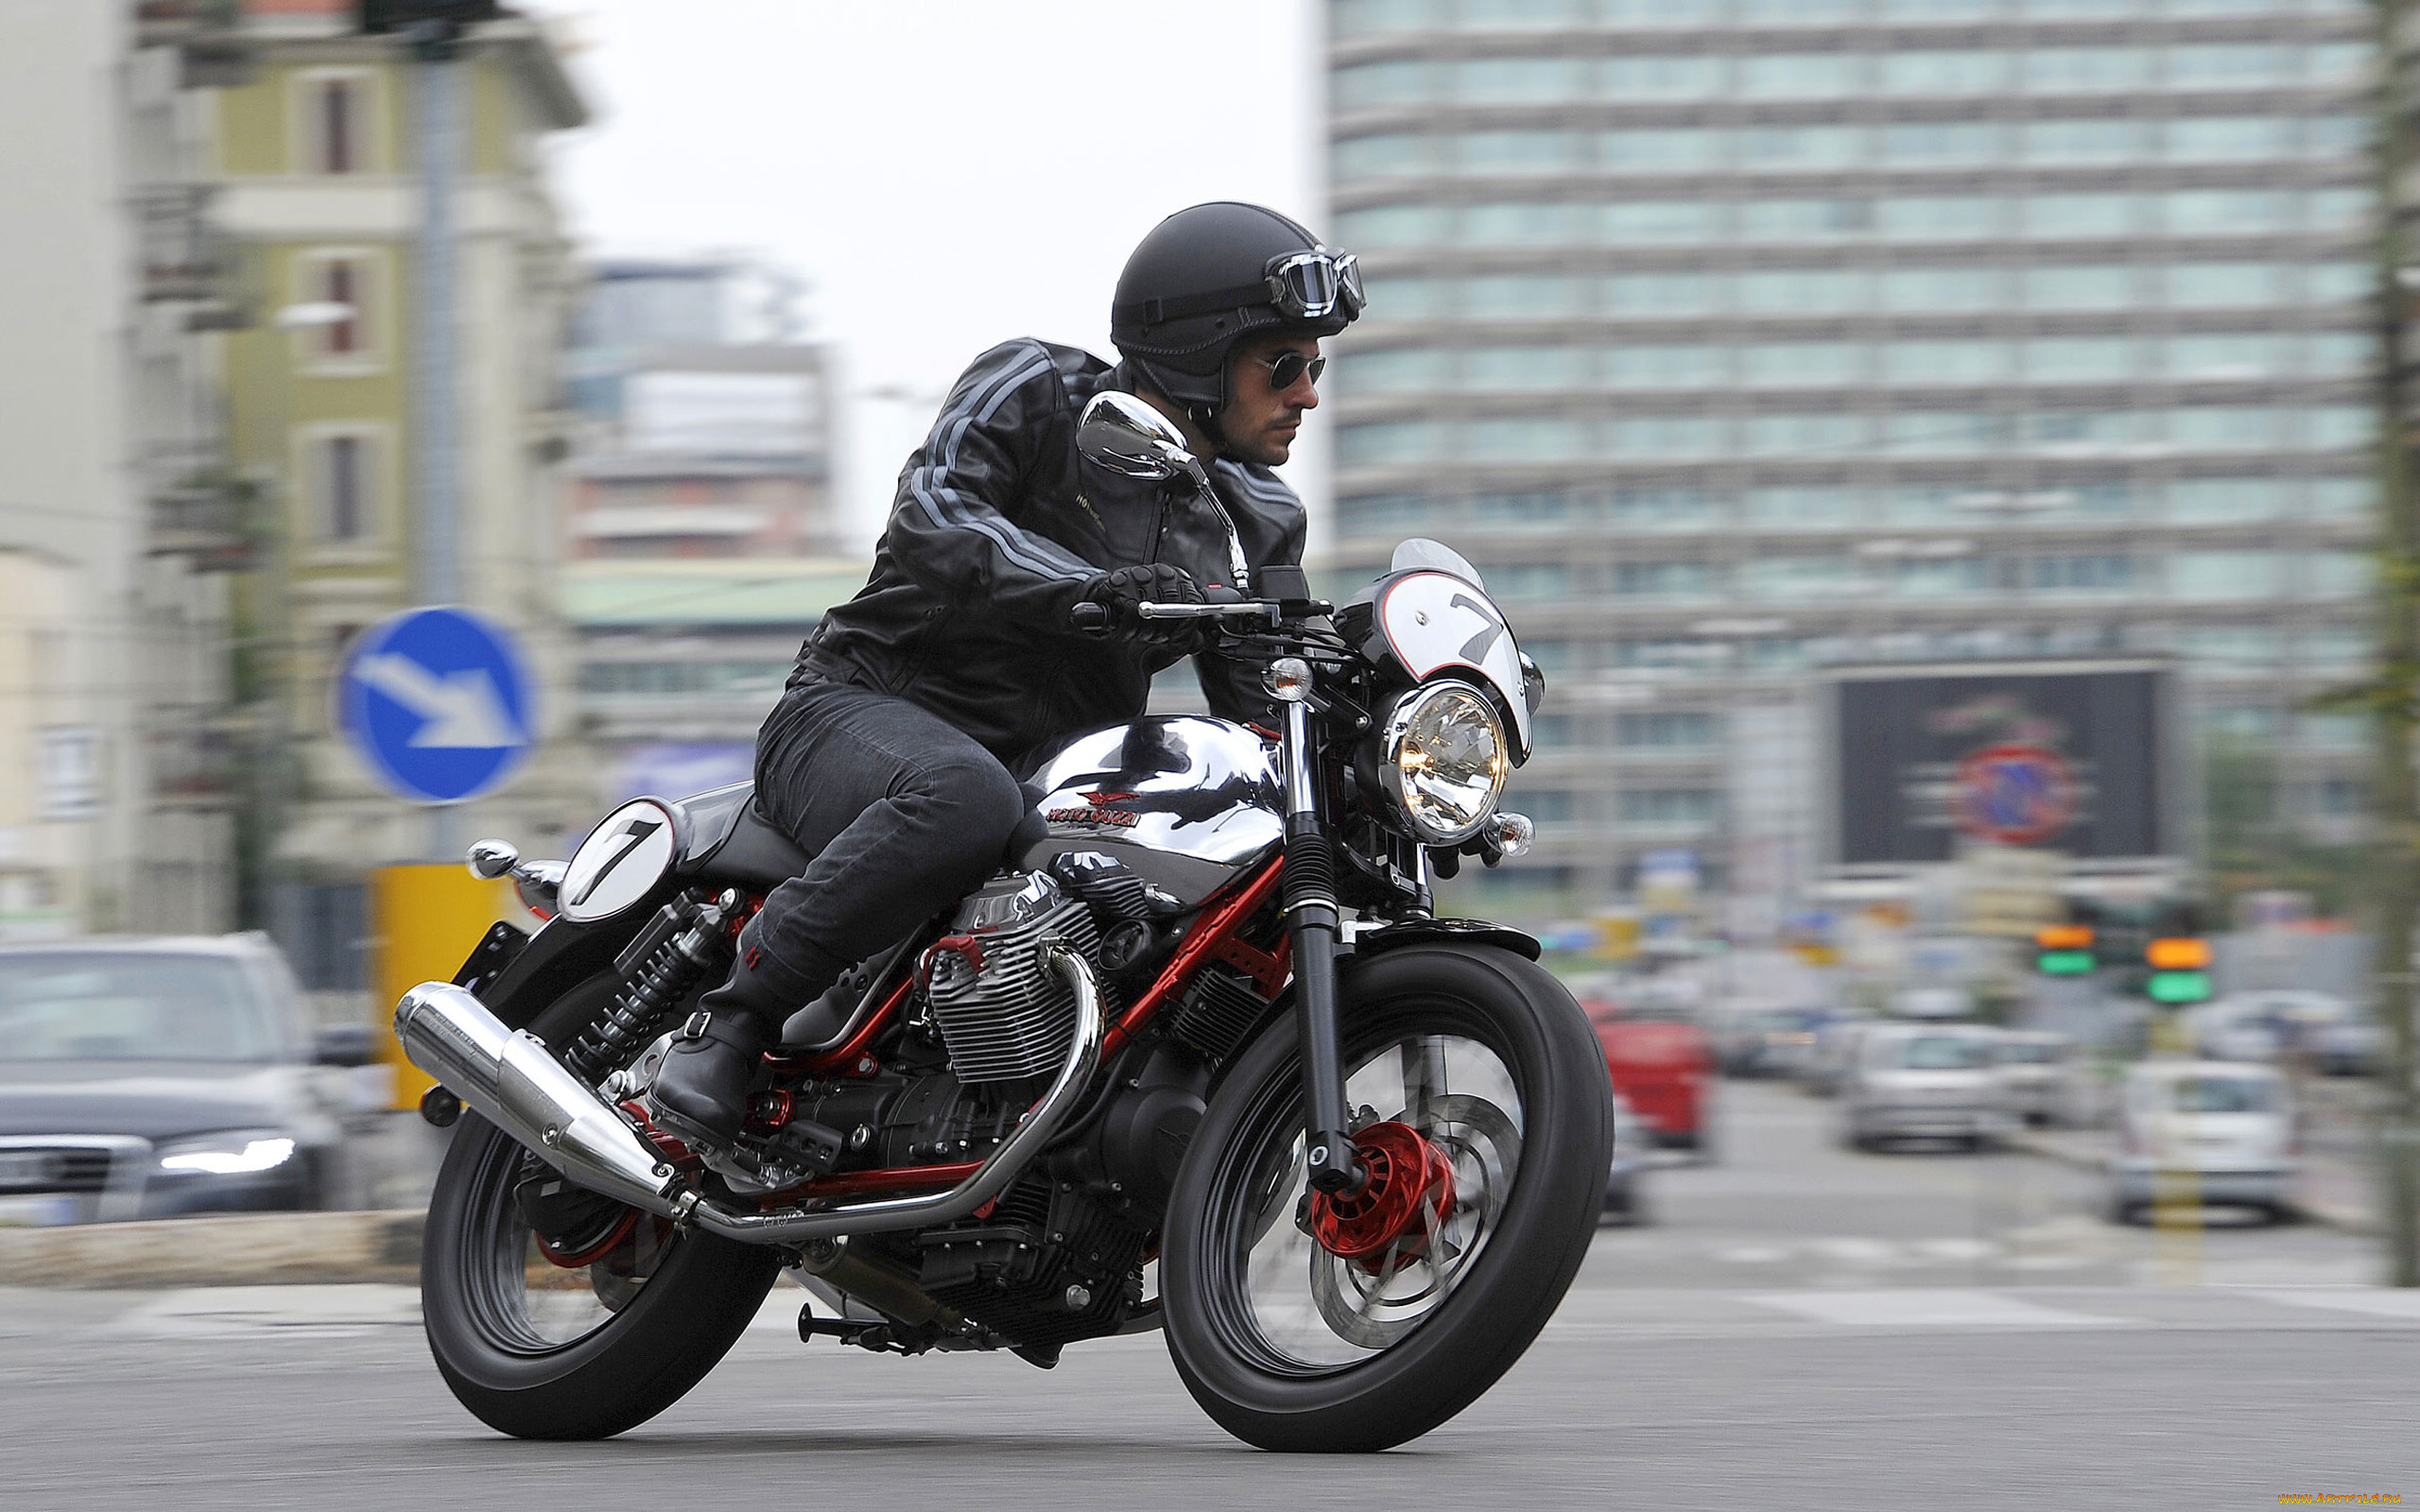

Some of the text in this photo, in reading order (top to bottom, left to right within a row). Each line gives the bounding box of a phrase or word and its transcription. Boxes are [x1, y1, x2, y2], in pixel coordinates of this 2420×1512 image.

[1450, 593, 1504, 665] 7
[1046, 808, 1141, 828] MOTO GUZZI
[570, 818, 664, 906] 7
